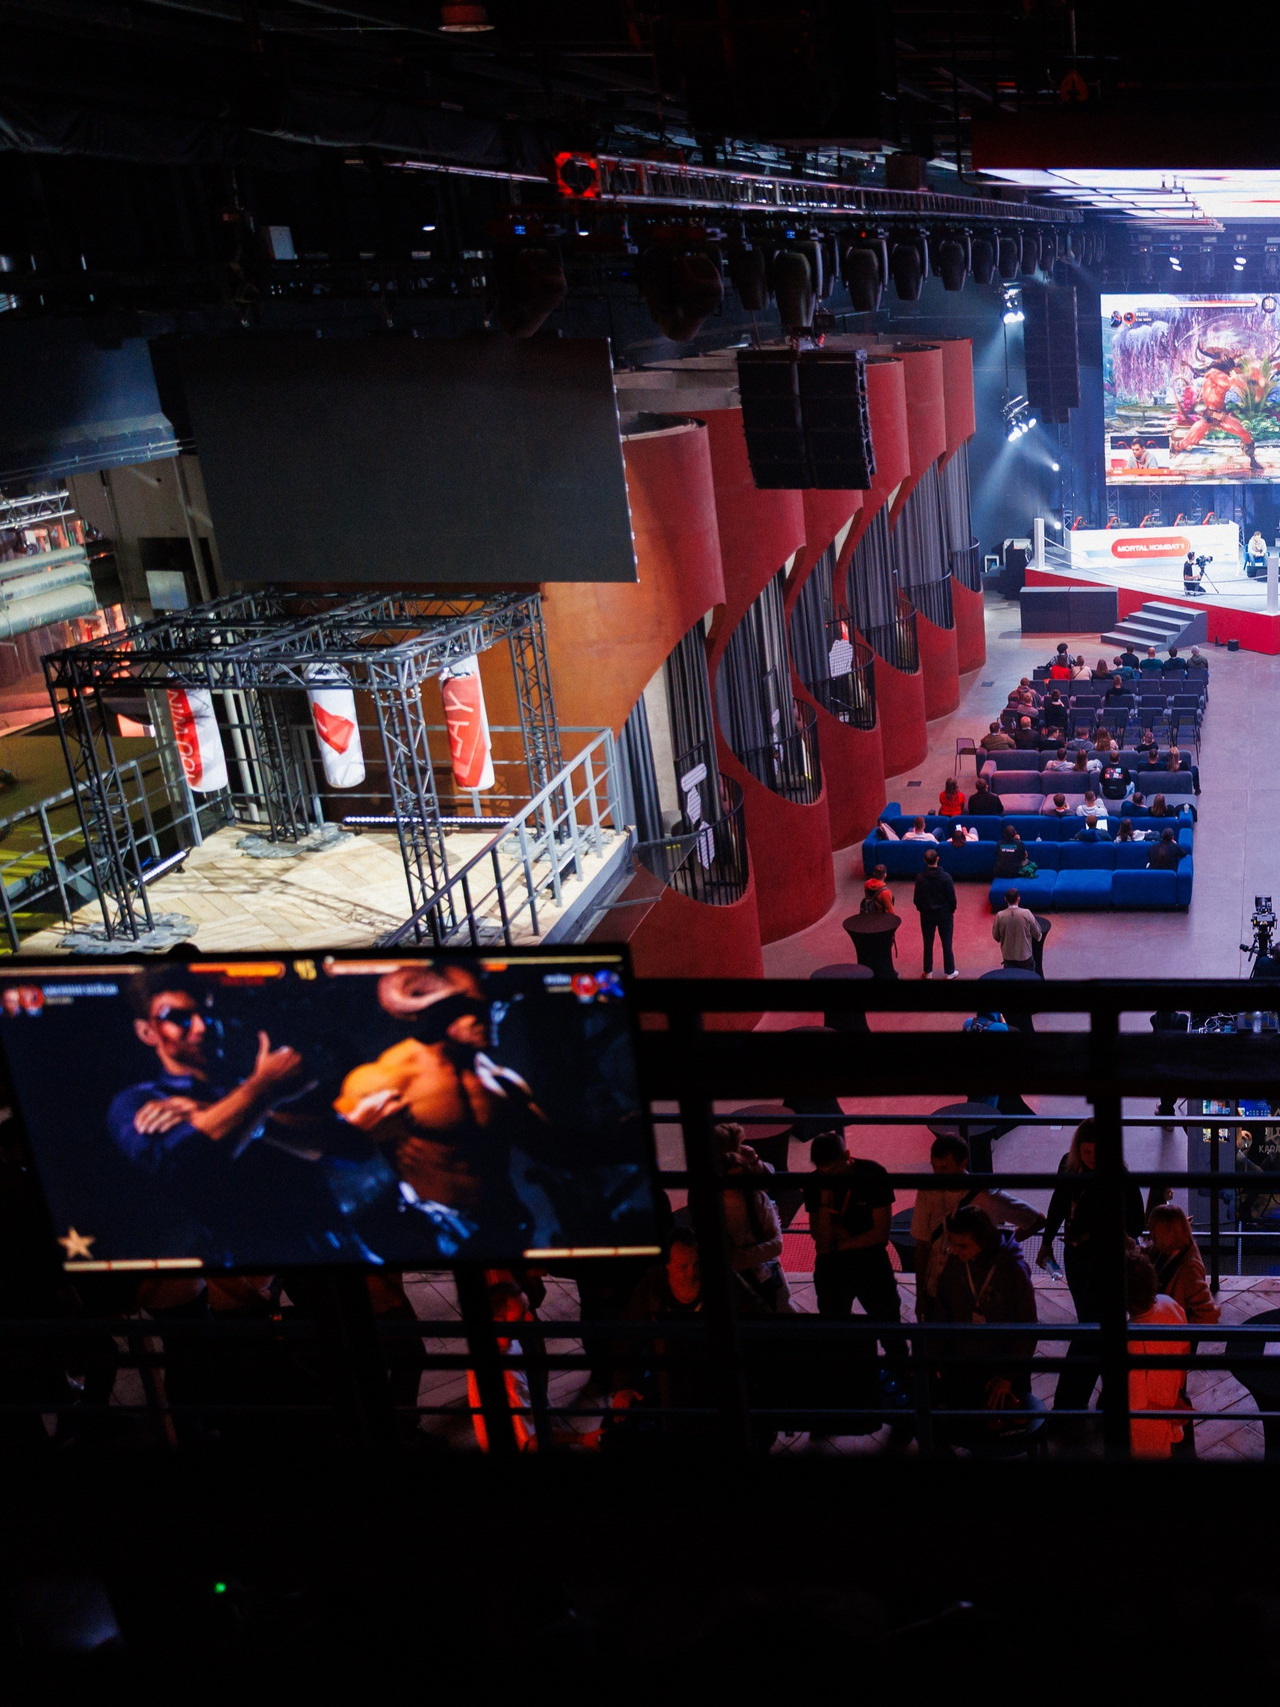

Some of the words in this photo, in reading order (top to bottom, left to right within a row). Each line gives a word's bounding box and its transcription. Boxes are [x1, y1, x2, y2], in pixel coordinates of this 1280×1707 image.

[1265, 299, 1274, 309] 90
[1117, 544, 1149, 552] MORTAL
[1149, 543, 1179, 551] KOMBAT
[445, 690, 474, 759] LAY
